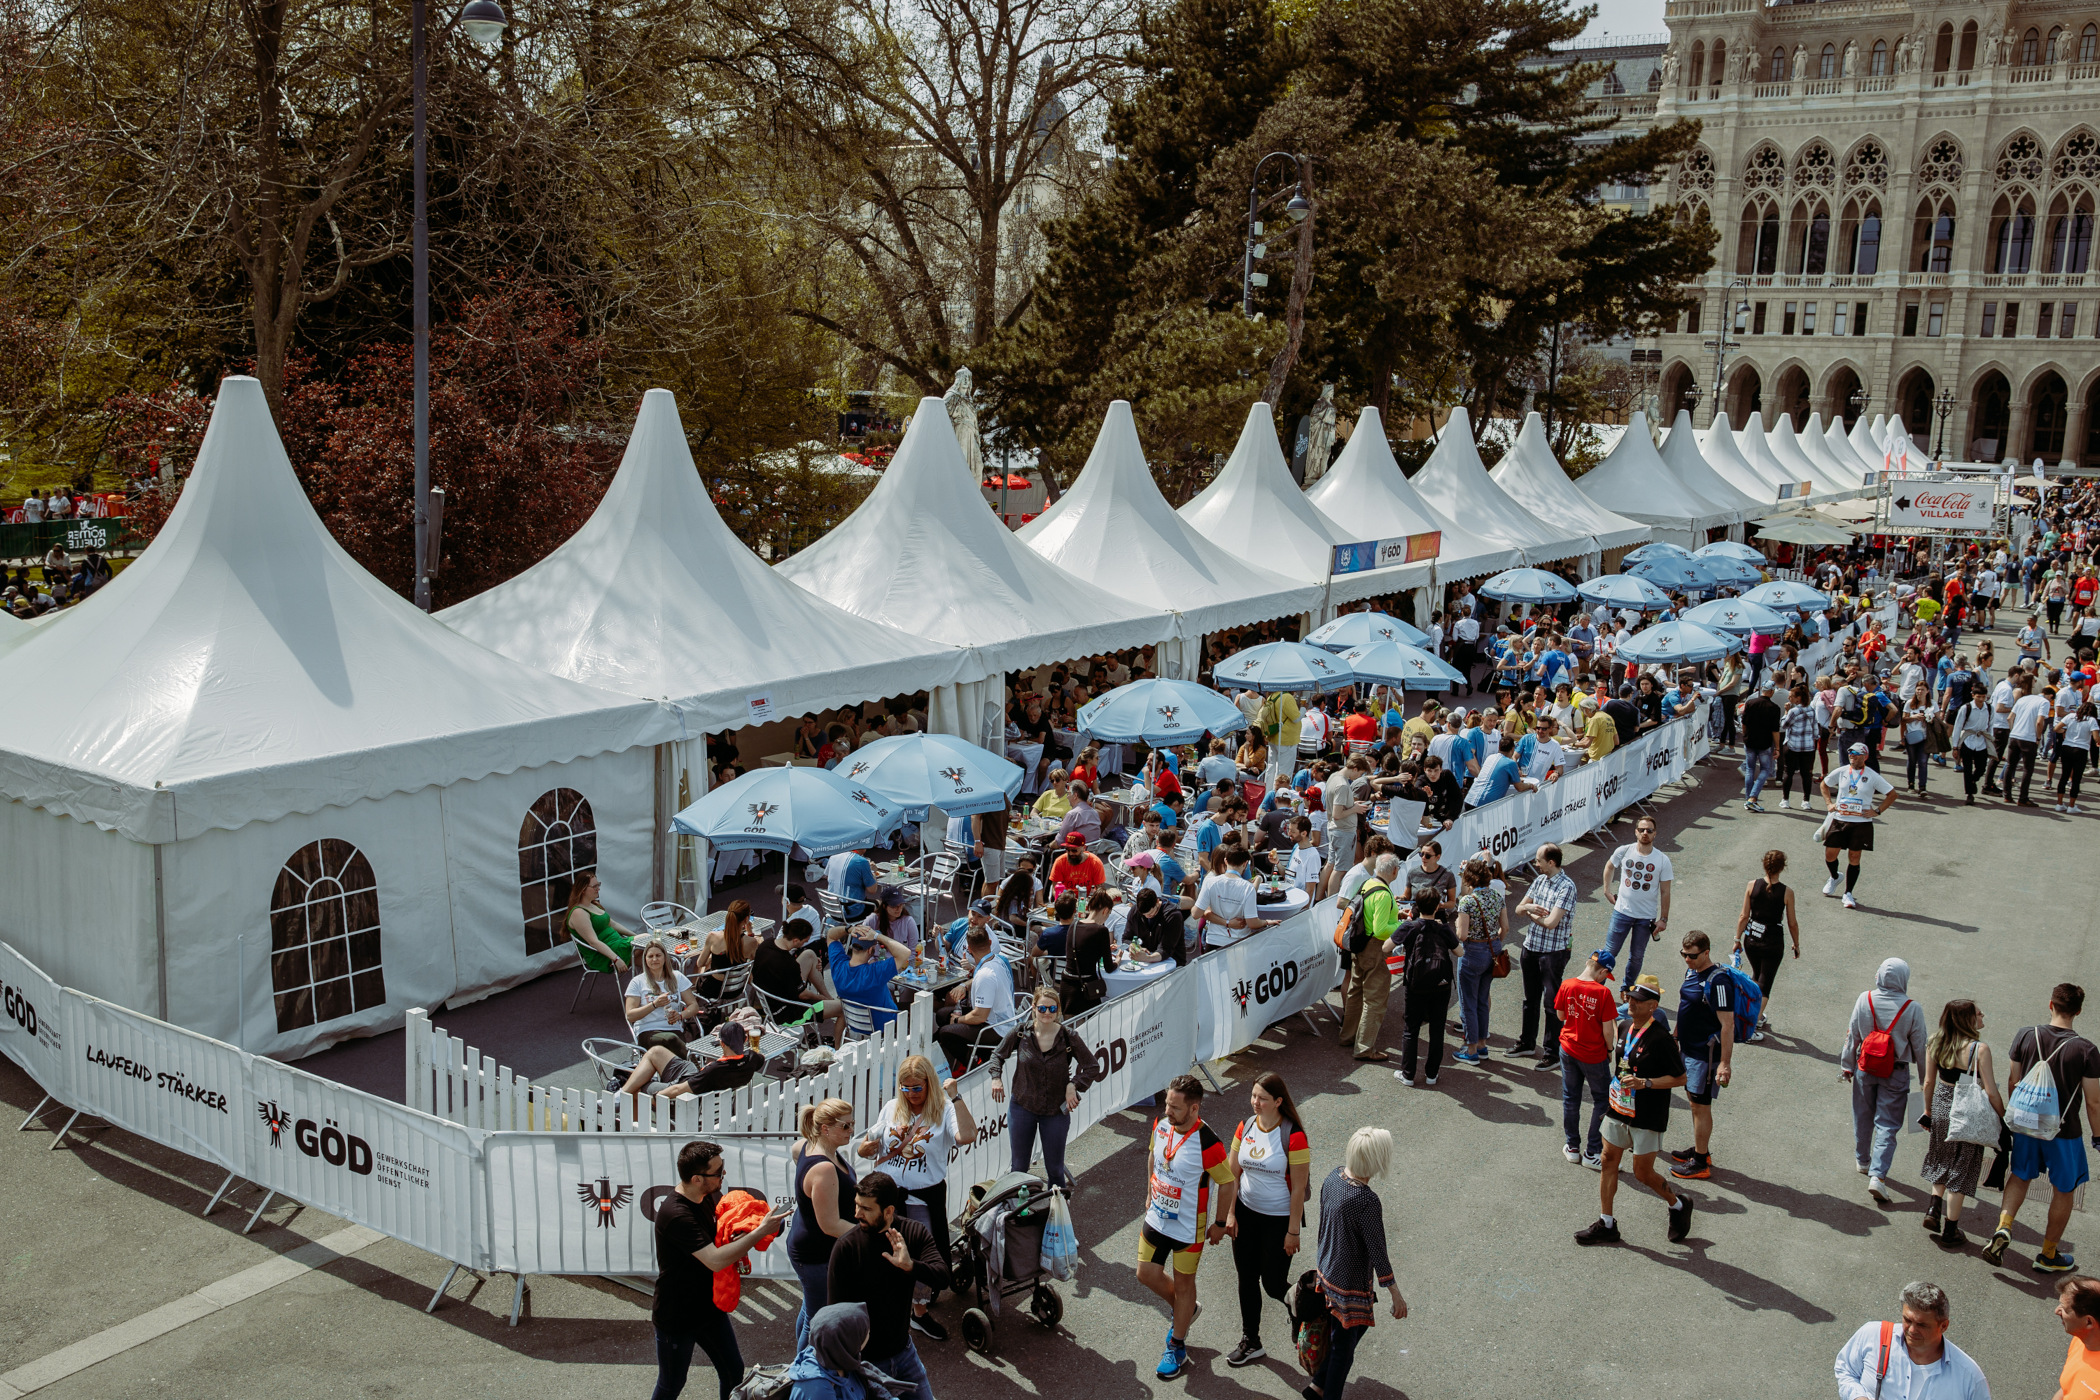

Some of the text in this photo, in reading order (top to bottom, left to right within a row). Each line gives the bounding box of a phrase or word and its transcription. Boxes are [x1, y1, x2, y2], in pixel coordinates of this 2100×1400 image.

[1920, 510, 1965, 519] VILLAGE
[1387, 542, 1401, 559] GÖD
[1652, 747, 1670, 771] GÖD
[914, 808, 925, 817] Tag
[812, 844, 840, 853] meinsam
[1493, 825, 1518, 857] GÖD
[1254, 960, 1298, 1005] GÖD
[4, 985, 37, 1037] GÖD
[1129, 1021, 1163, 1045] GEWERKSCHAFT
[1129, 1032, 1164, 1054] ÖFFENTLICHER
[1083, 1037, 1128, 1084] ÖD
[1129, 1050, 1146, 1064] DIENST
[86, 1044, 228, 1114] LAUFEND STÄRKER
[295, 1117, 373, 1176] GÖD
[376, 1151, 431, 1178] GEWERKSCHAFT
[376, 1161, 430, 1189] ÖFFENTLICHER
[377, 1174, 402, 1190] DIENST
